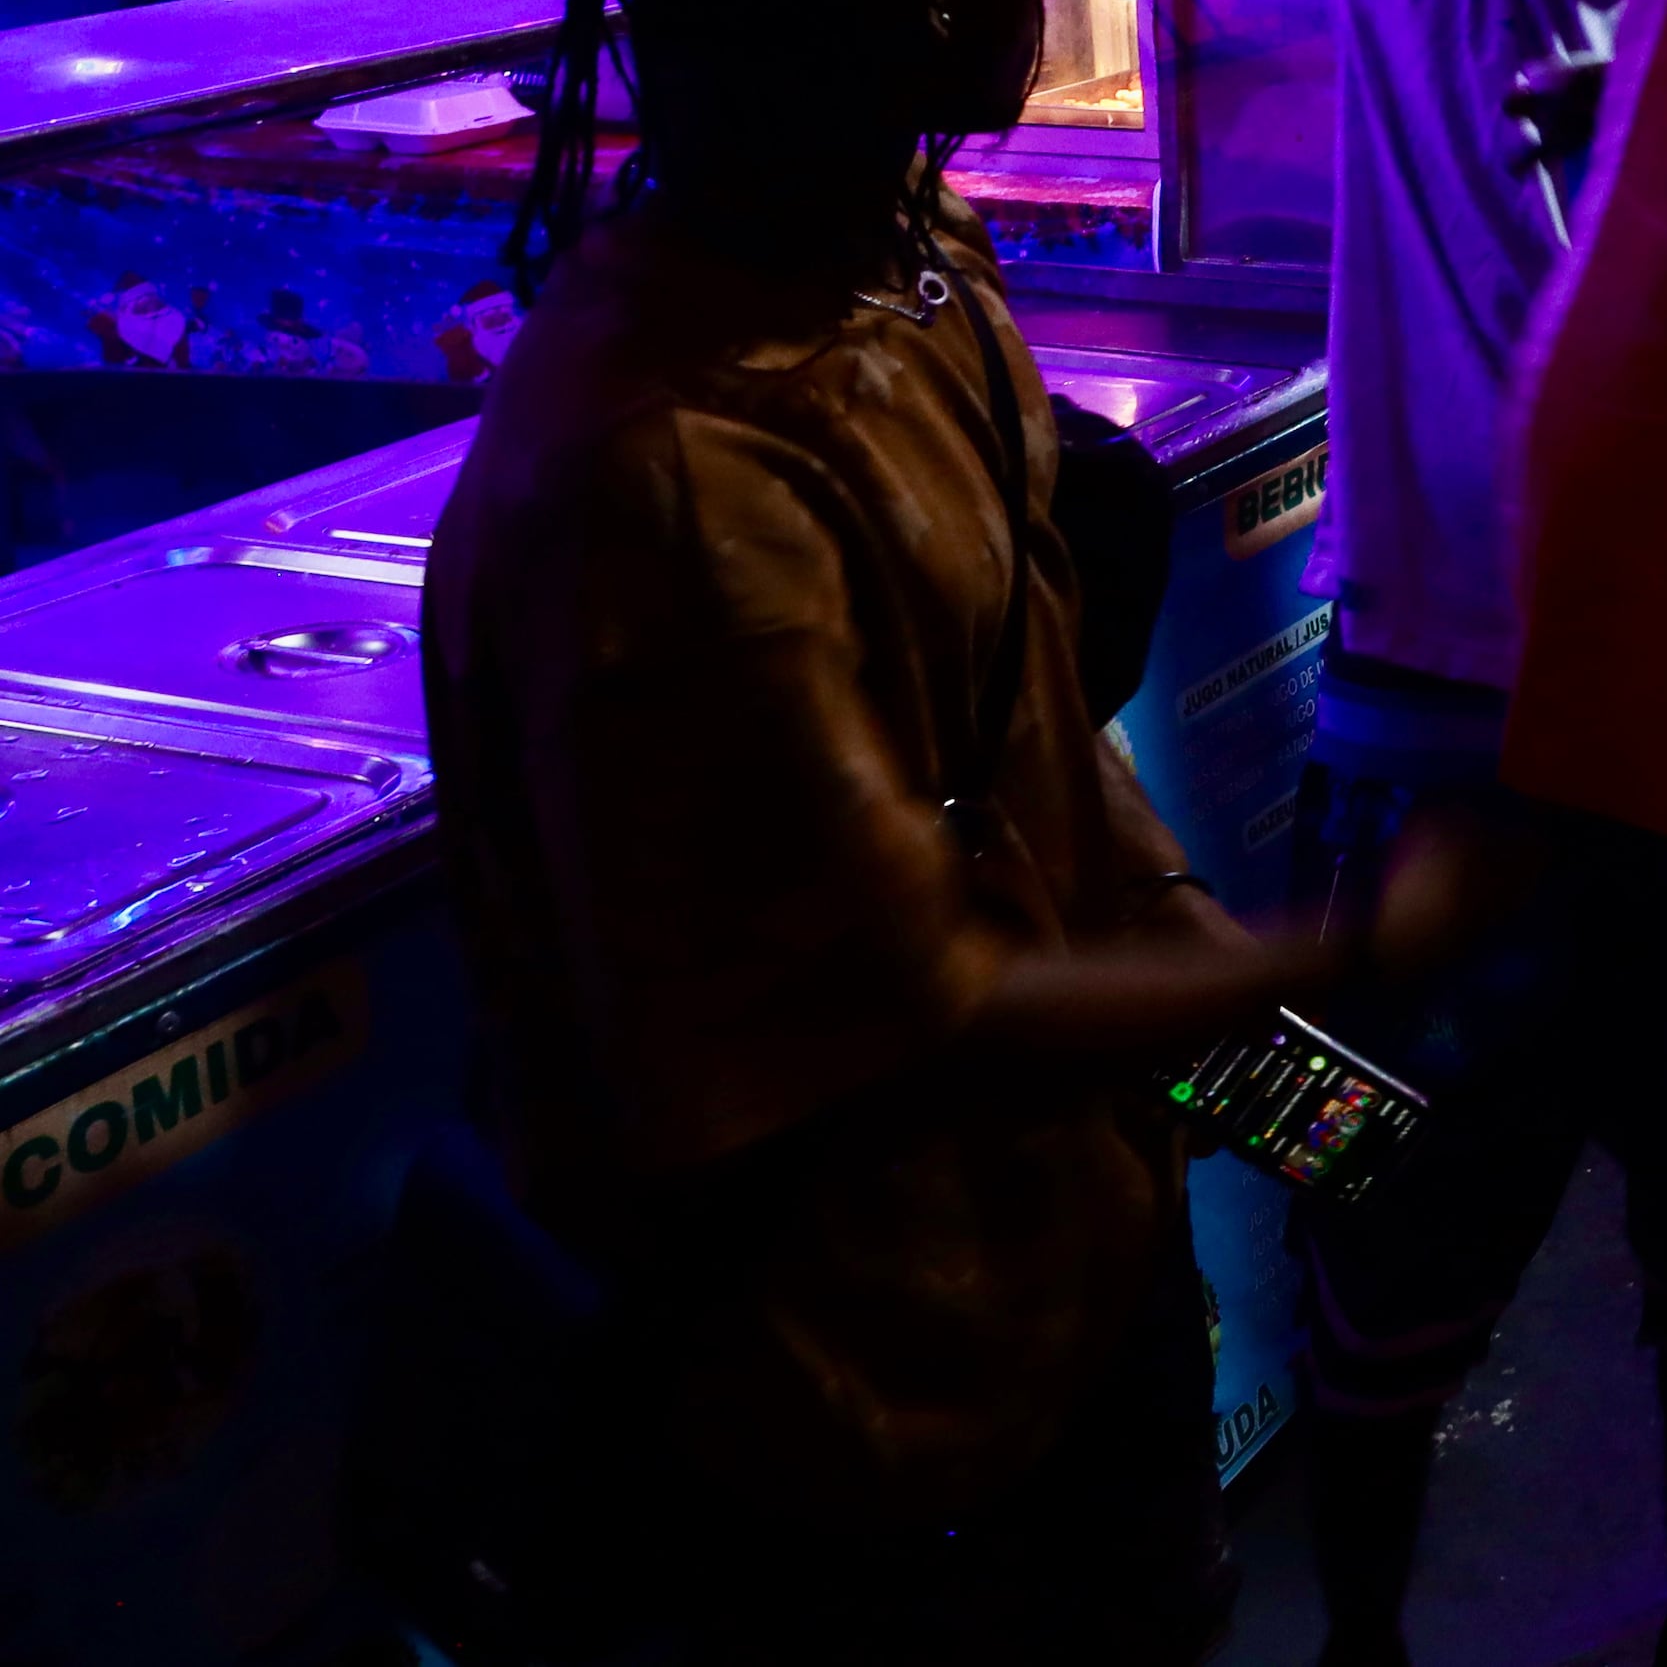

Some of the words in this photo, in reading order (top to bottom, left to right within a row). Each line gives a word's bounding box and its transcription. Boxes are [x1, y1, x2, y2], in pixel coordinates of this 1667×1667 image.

[1184, 678, 1224, 717] JUGO
[1227, 636, 1293, 692] NATURAL
[1302, 612, 1330, 641] JUS
[3, 989, 343, 1211] COMIDA
